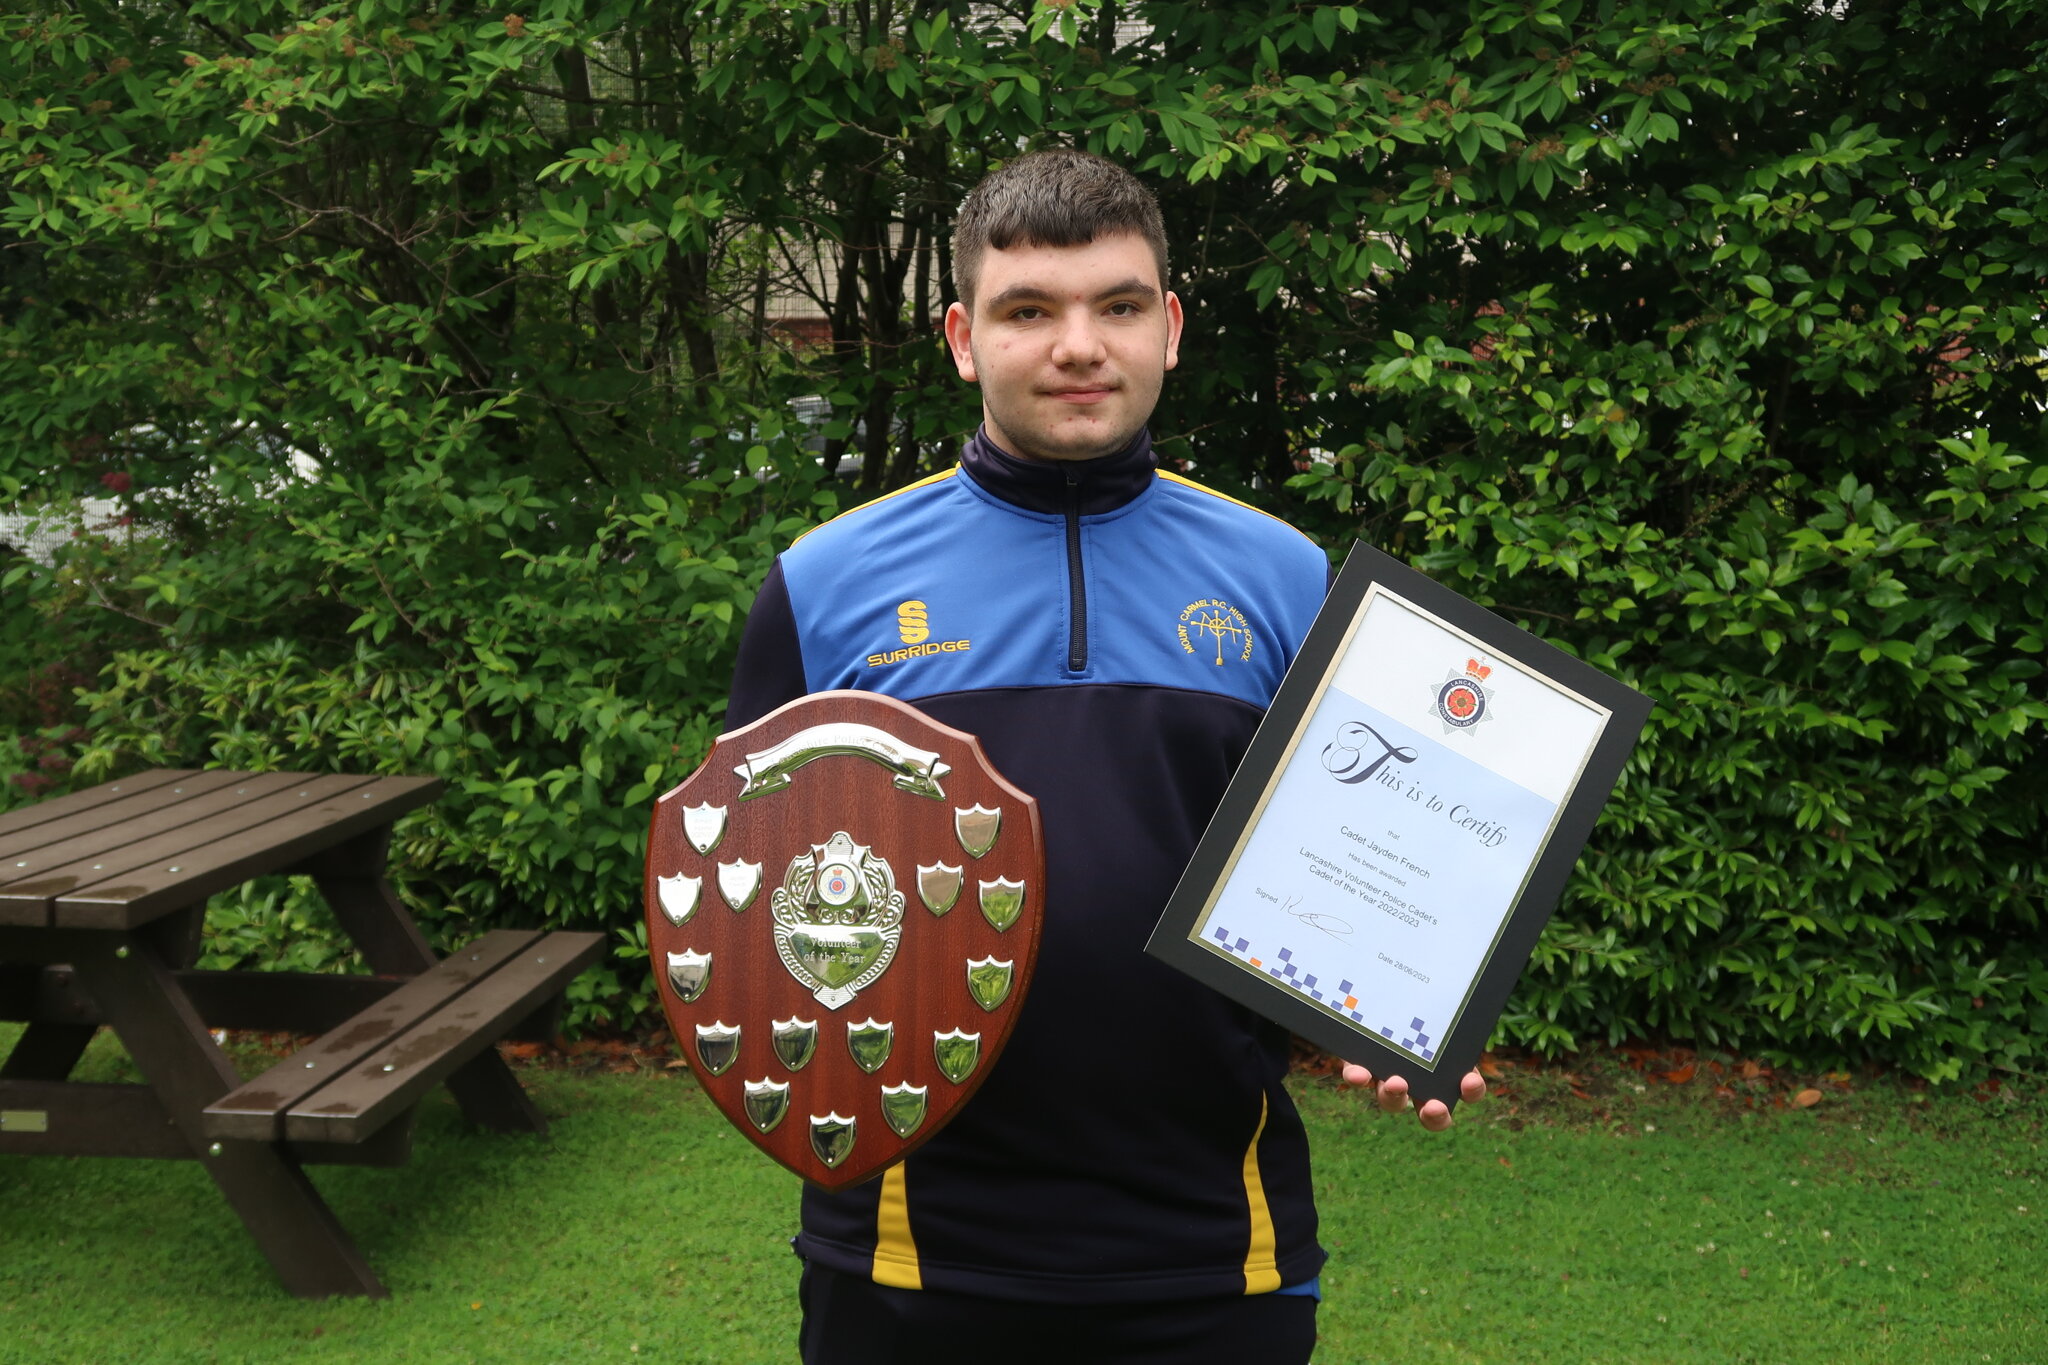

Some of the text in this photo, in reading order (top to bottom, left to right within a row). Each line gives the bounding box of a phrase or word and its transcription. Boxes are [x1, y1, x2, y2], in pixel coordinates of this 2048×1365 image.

[1180, 599, 1211, 621] CARMEL
[1229, 606, 1249, 627] HIGH
[867, 639, 971, 667] SURRIDGE
[1178, 624, 1196, 654] MOUNT
[1241, 628, 1253, 662] SCHOOL
[1450, 680, 1484, 701] LANCASHIRE
[1438, 702, 1475, 727] CONSTABULARY
[1321, 721, 1507, 847] This is to Certify
[1387, 830, 1401, 841] that
[1340, 825, 1431, 879] Cadet Jayden French
[1348, 852, 1407, 887] Has been awarded
[1255, 887, 1279, 904] Signed
[1299, 847, 1438, 926] Lancashire Volunteer Police Cadet's
[1309, 864, 1420, 928] Cadet of the Year 2022/2023
[811, 938, 862, 949] Volunteer
[804, 952, 866, 964] of the Year
[1377, 951, 1431, 984] Date 28/06/2023
